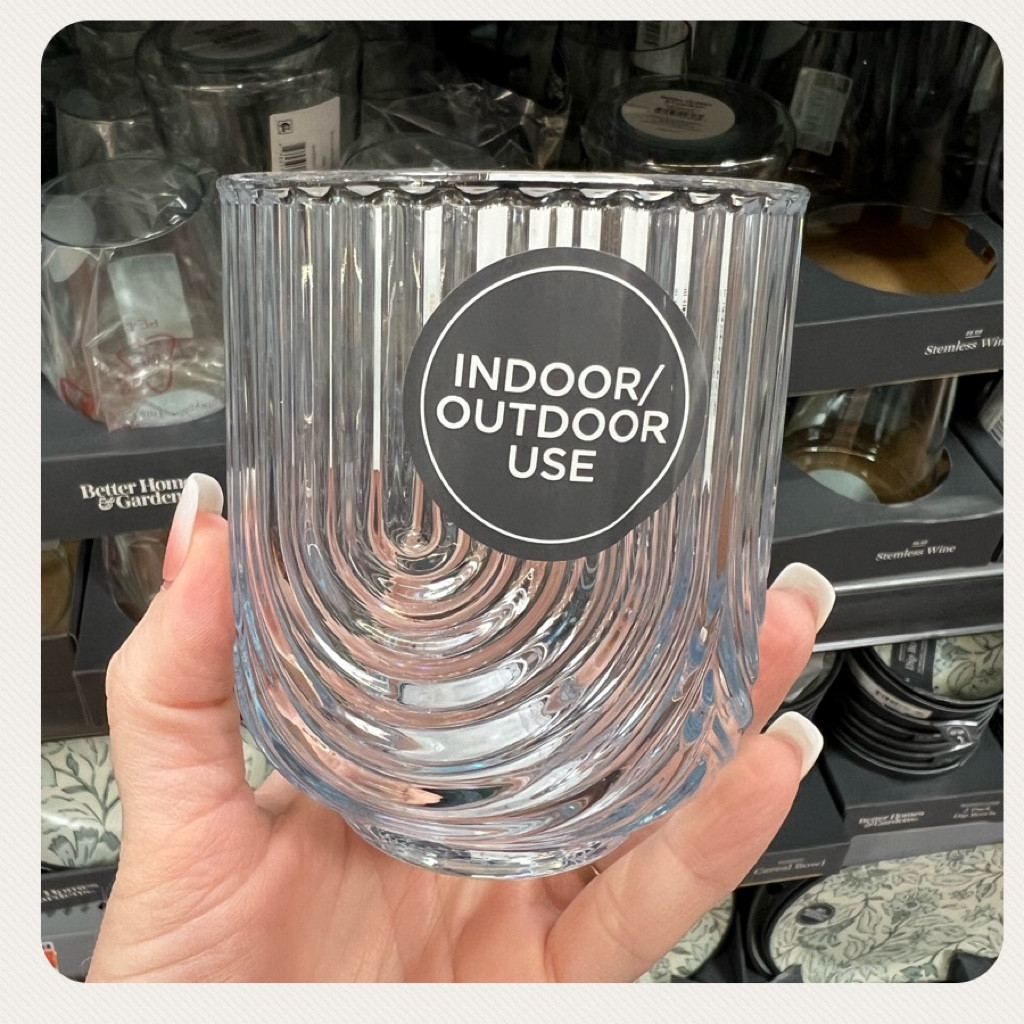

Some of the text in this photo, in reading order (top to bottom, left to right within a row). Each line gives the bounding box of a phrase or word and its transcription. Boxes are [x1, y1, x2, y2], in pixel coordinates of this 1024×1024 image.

[925, 340, 978, 356] Stemless
[454, 353, 665, 406] INDOOR/
[436, 395, 669, 444] OUTDOOR
[508, 445, 597, 483] USE
[80, 478, 186, 499] Better Hom
[98, 492, 182, 511] &Garden
[927, 545, 957, 555] Wine
